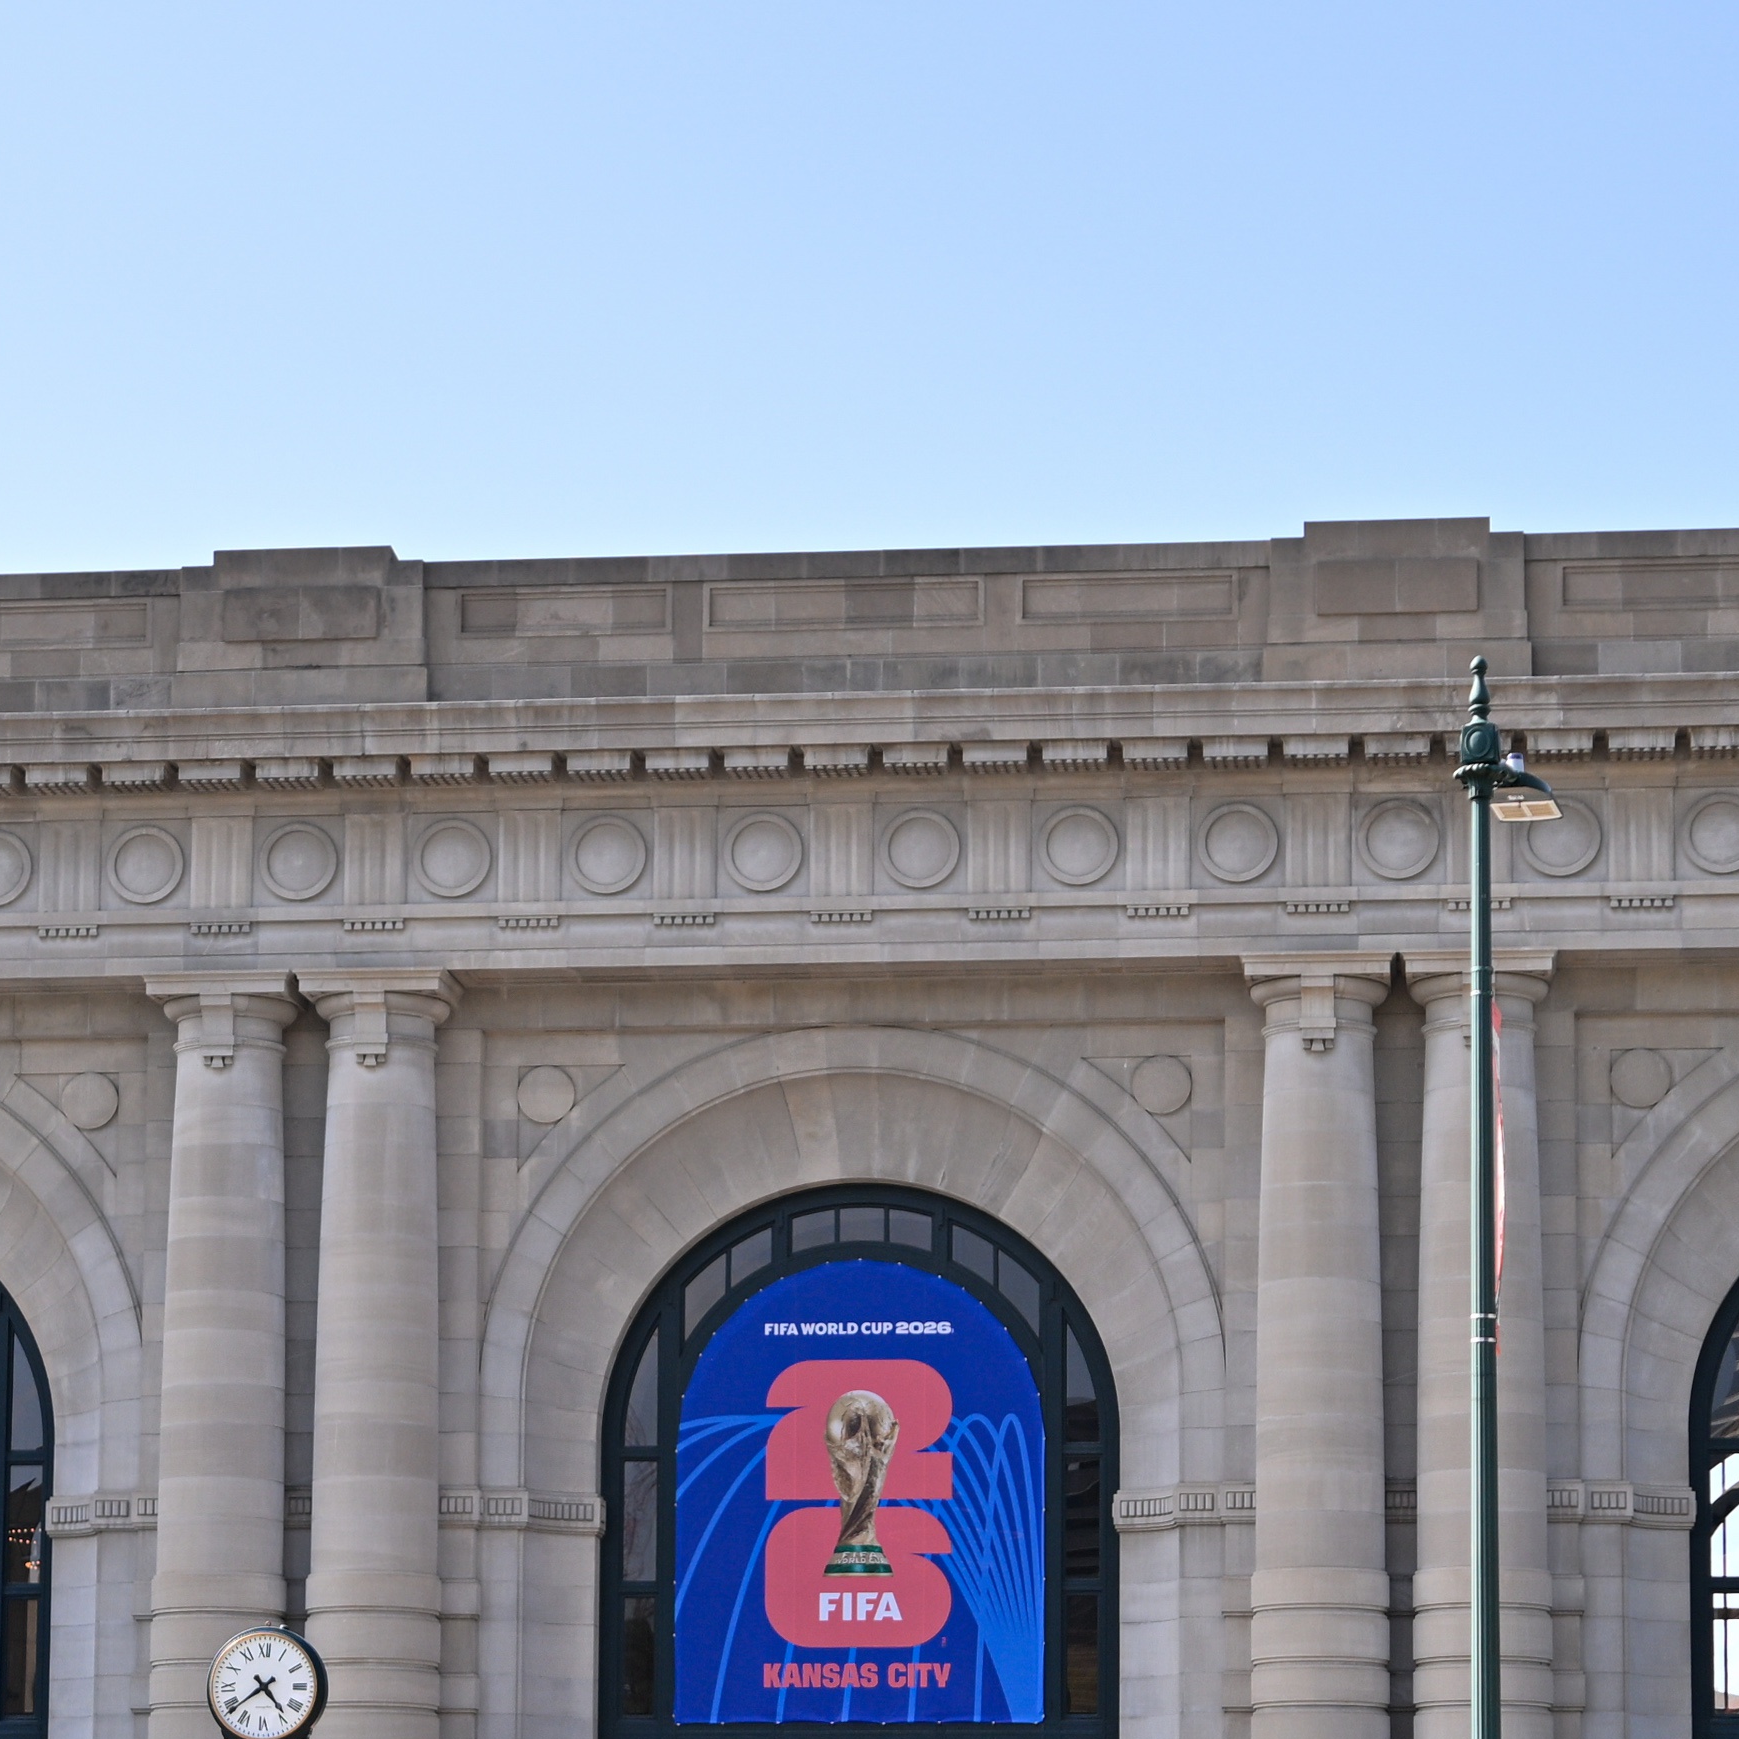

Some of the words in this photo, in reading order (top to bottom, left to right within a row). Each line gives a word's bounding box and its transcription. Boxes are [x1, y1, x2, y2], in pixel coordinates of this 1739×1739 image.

[764, 1323, 798, 1336] FIFA
[800, 1322, 859, 1335] WORLD
[861, 1322, 893, 1334] CUP
[895, 1321, 952, 1334] 2026
[819, 1592, 903, 1621] FIFA
[763, 1663, 879, 1689] KANSAS
[887, 1663, 951, 1688] CITY
